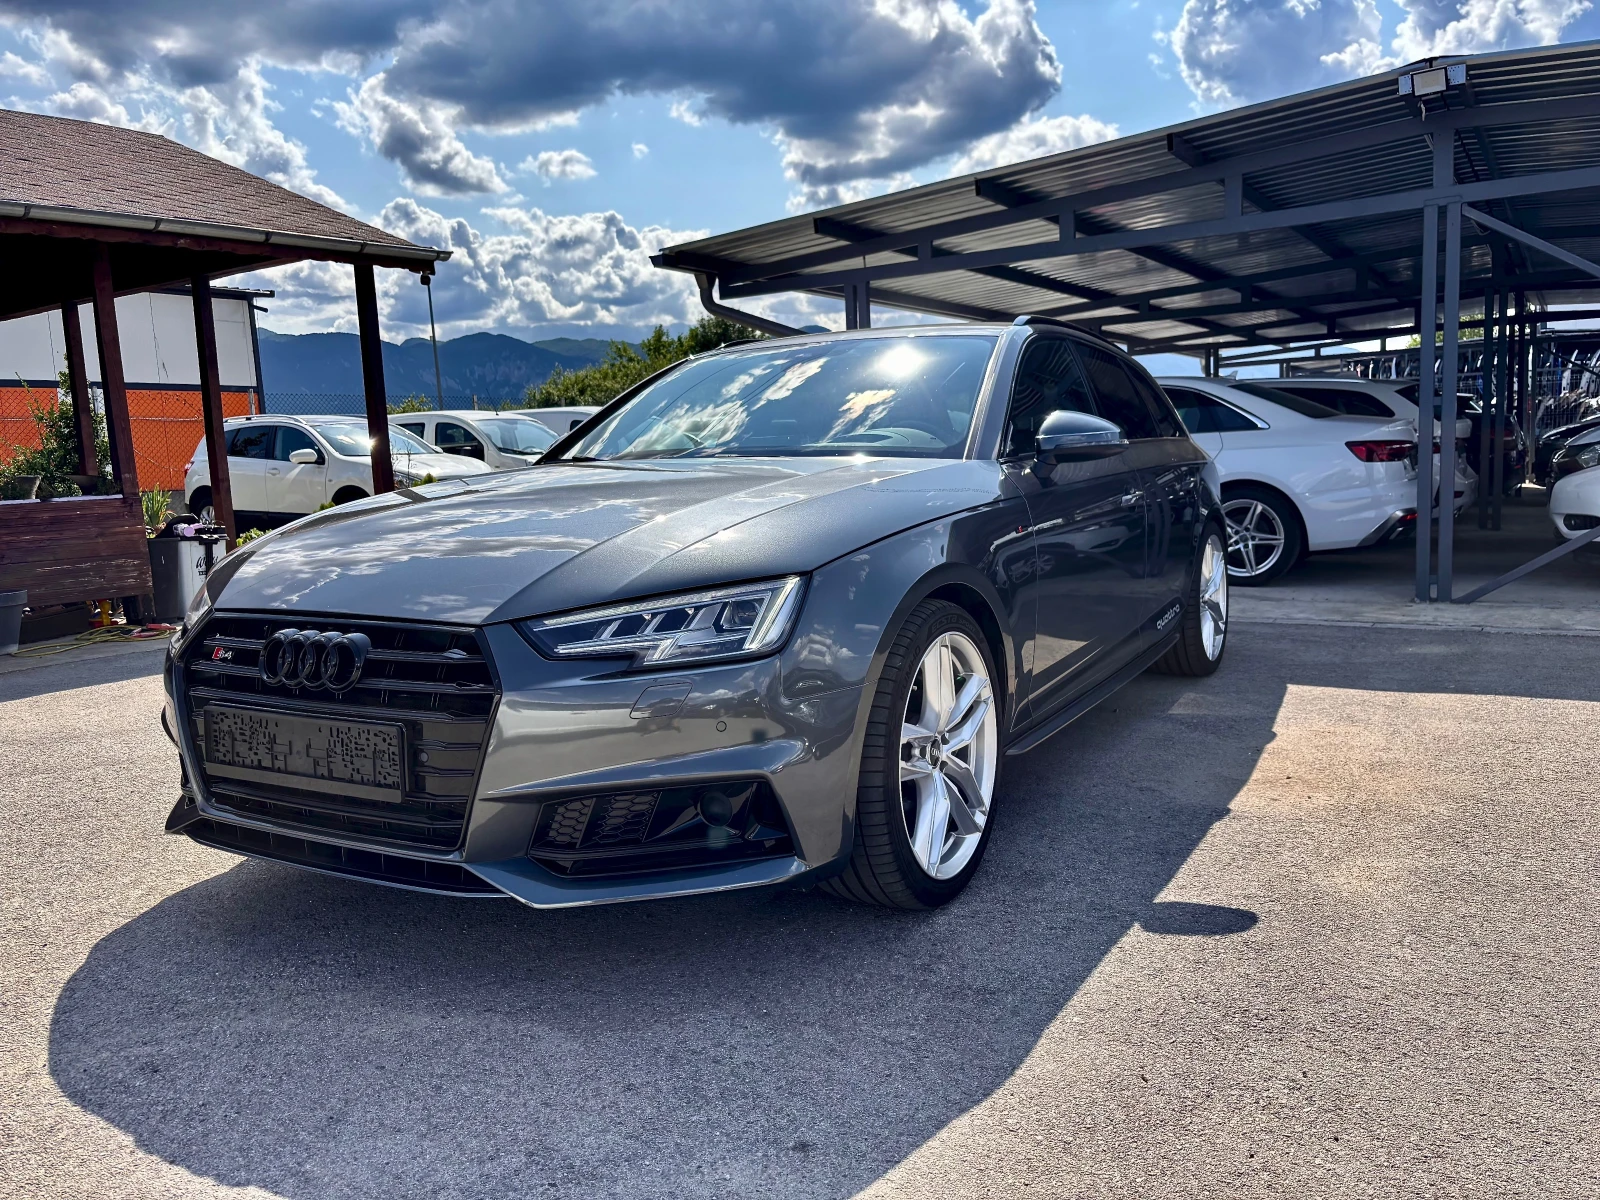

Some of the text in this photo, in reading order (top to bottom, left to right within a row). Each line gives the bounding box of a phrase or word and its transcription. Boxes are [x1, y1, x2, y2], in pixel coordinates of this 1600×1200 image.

[958, 618, 976, 632] SPORT
[1156, 604, 1180, 630] quattro
[215, 648, 232, 660] S4
[899, 645, 921, 702] KUMHO
